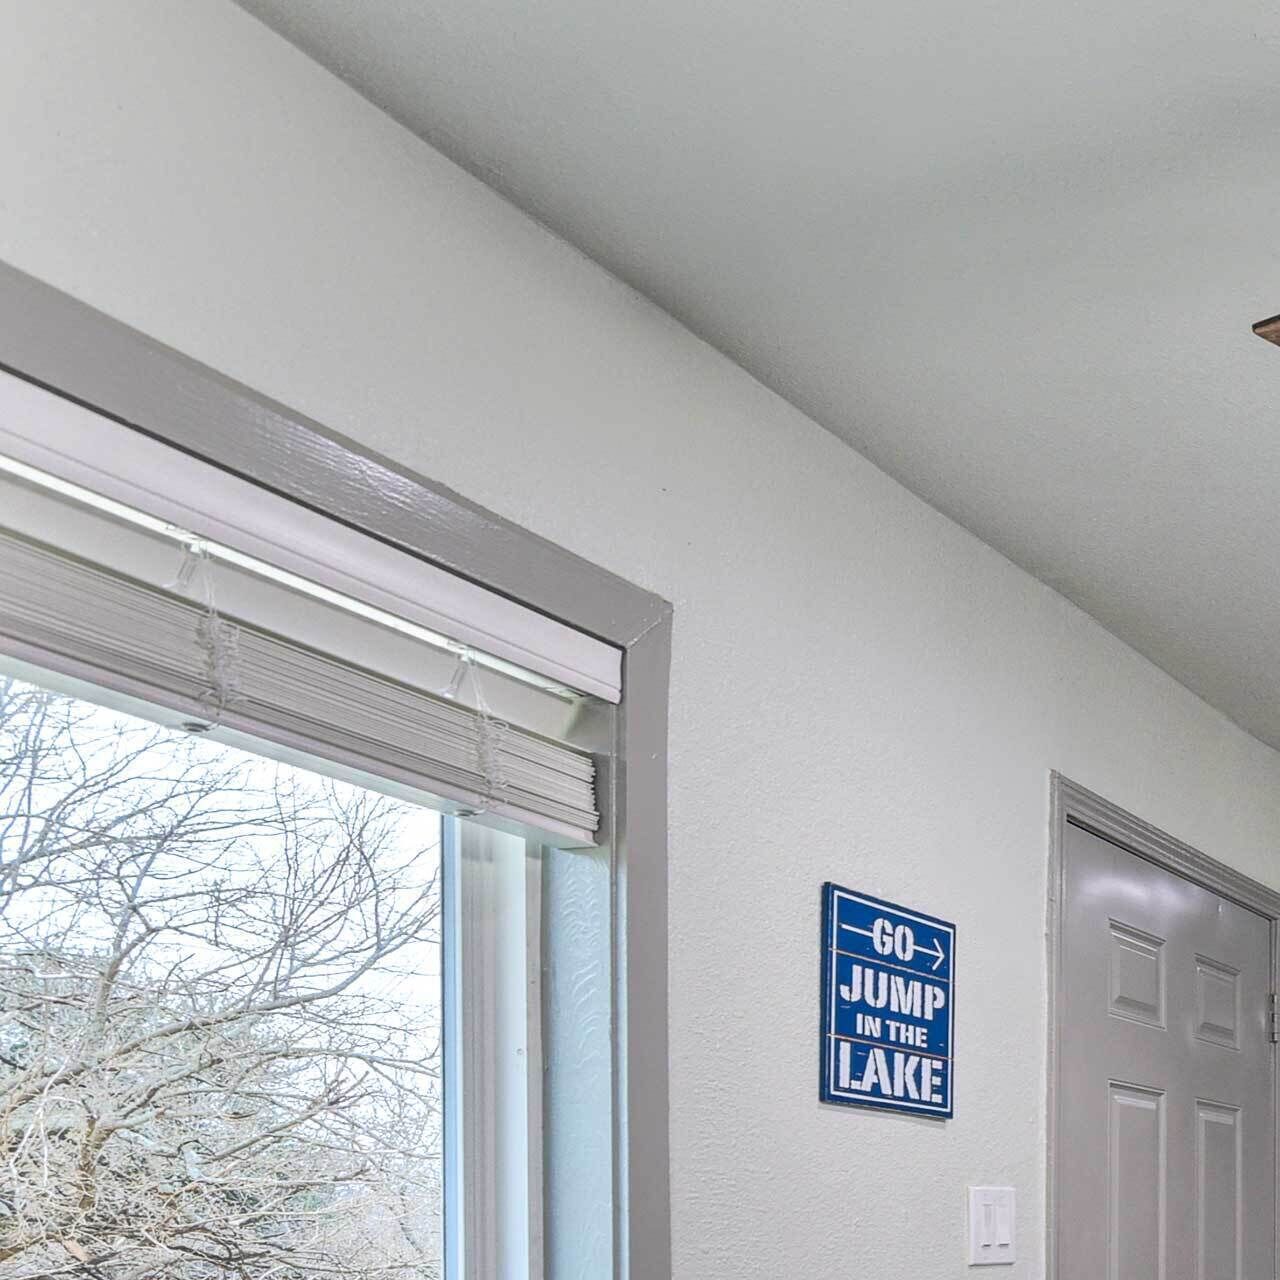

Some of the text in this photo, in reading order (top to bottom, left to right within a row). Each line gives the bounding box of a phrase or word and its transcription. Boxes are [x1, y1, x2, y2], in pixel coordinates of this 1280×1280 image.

[872, 918, 915, 962] GO
[839, 963, 946, 1021] JUMP
[856, 1012, 928, 1048] IN THE
[838, 1041, 943, 1104] LAKE
